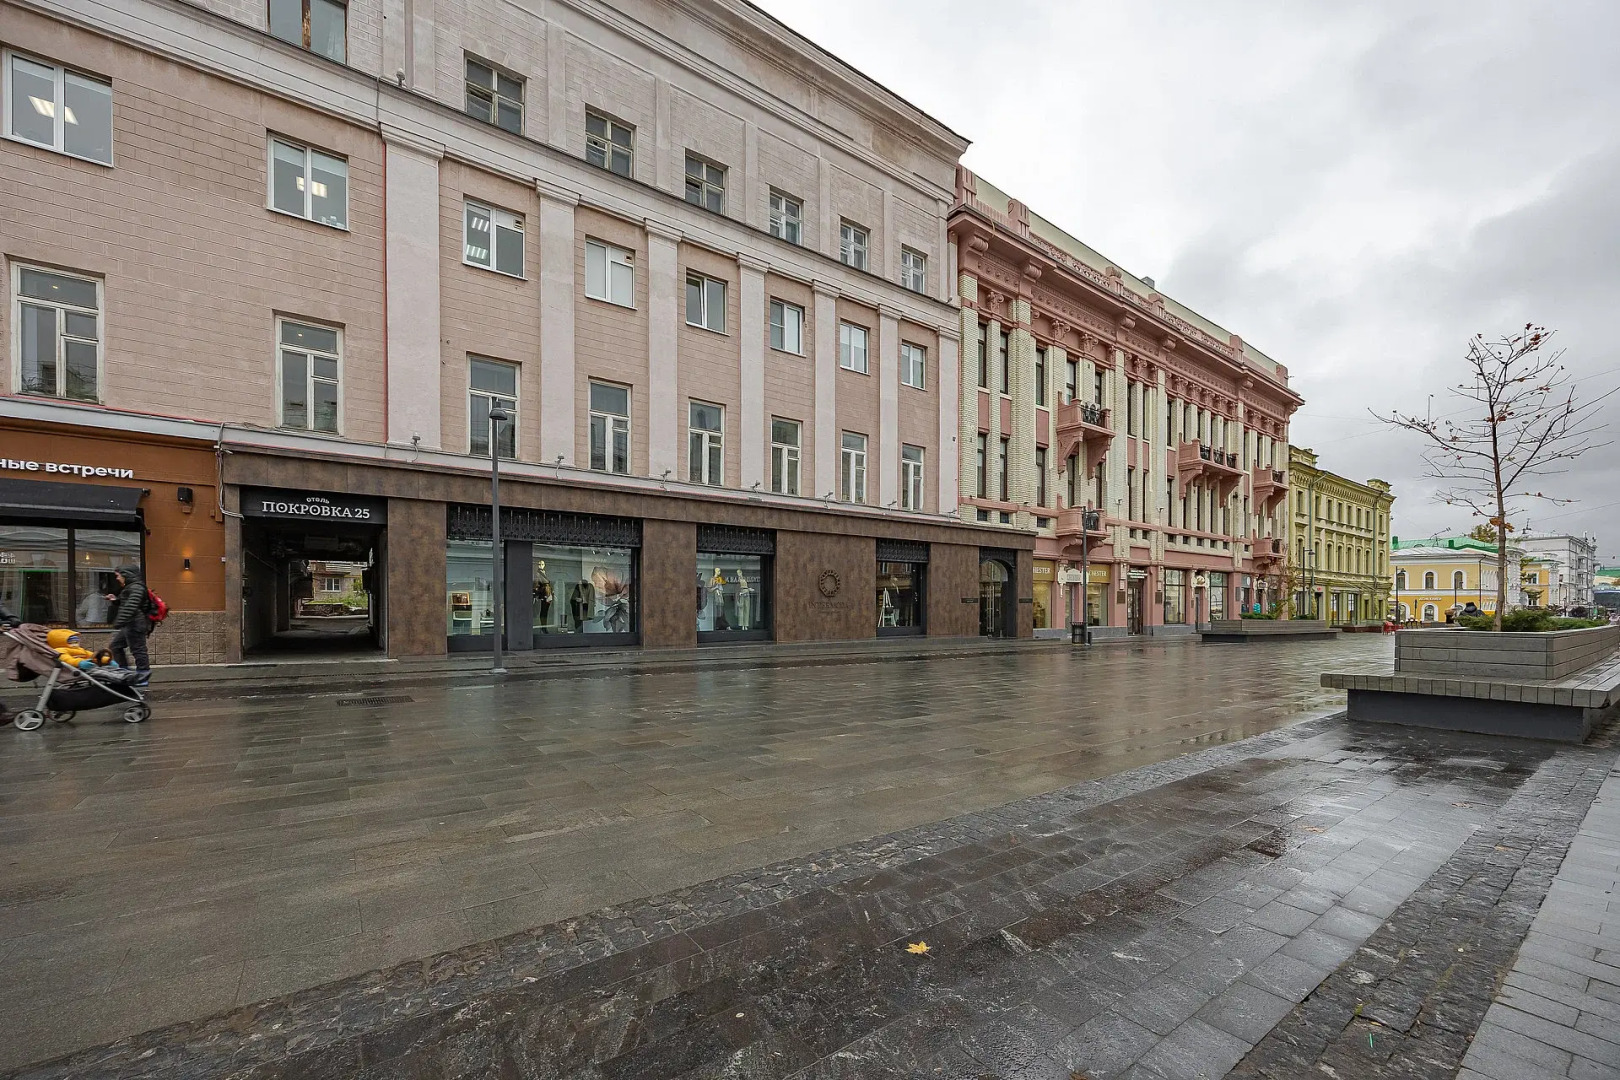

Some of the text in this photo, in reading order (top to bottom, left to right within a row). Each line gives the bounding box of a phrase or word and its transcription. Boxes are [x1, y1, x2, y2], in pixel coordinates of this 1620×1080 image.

[45, 462, 134, 479] встречи
[261, 501, 370, 519] ПОКРОВКА 25
